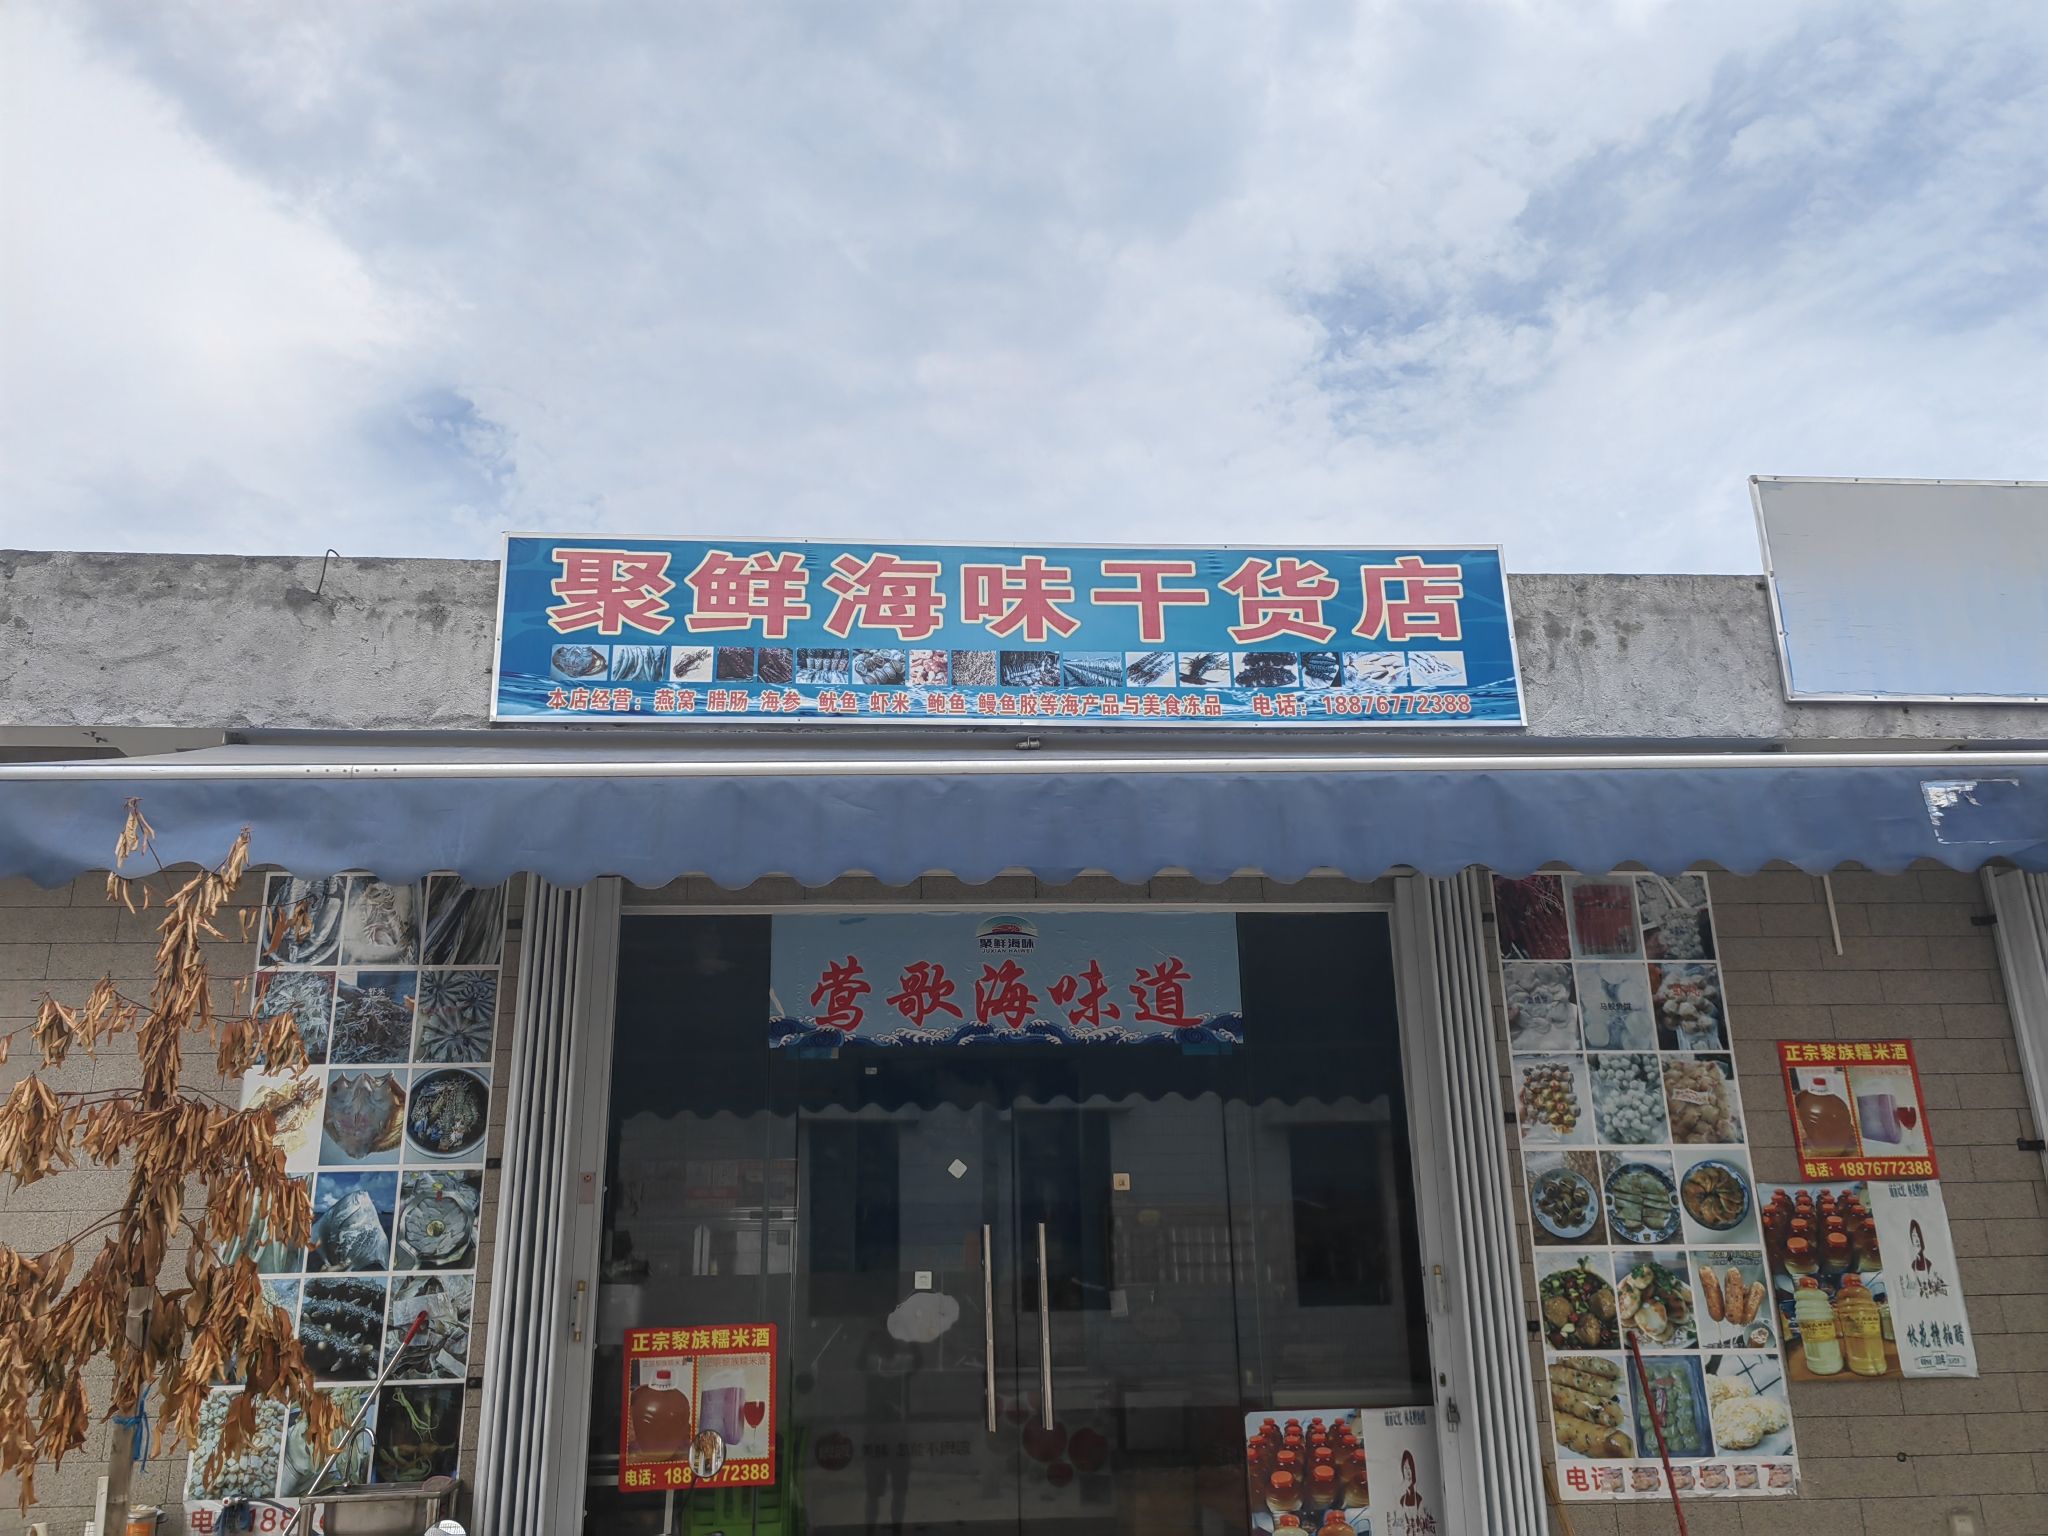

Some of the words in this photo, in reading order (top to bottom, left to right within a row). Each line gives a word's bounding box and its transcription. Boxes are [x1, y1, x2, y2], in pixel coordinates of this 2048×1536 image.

[547, 549, 1463, 643] 聚鲜海味干货店
[548, 688, 641, 711] 本店经营：
[654, 688, 695, 711] 燕窝
[707, 689, 748, 712] 腊肠
[760, 689, 801, 712] 海参
[818, 690, 858, 713] 鱿鱼
[870, 690, 910, 713] 虾米
[927, 692, 966, 714] 鲍鱼
[977, 692, 1222, 716] 鳗鱼胶等海产品与美食冻品
[1252, 693, 1308, 717] 电话：
[1322, 694, 1472, 714] 18876772388
[810, 955, 1204, 1032] 莺歌海味道
[1784, 1043, 1909, 1062] 正宗黎族糯米酒
[1805, 1162, 1834, 1178] 电话：
[1839, 1160, 1933, 1177] 18876772388
[631, 1327, 770, 1352] 正宗黎族糯米酒
[625, 1468, 656, 1487] 电话：
